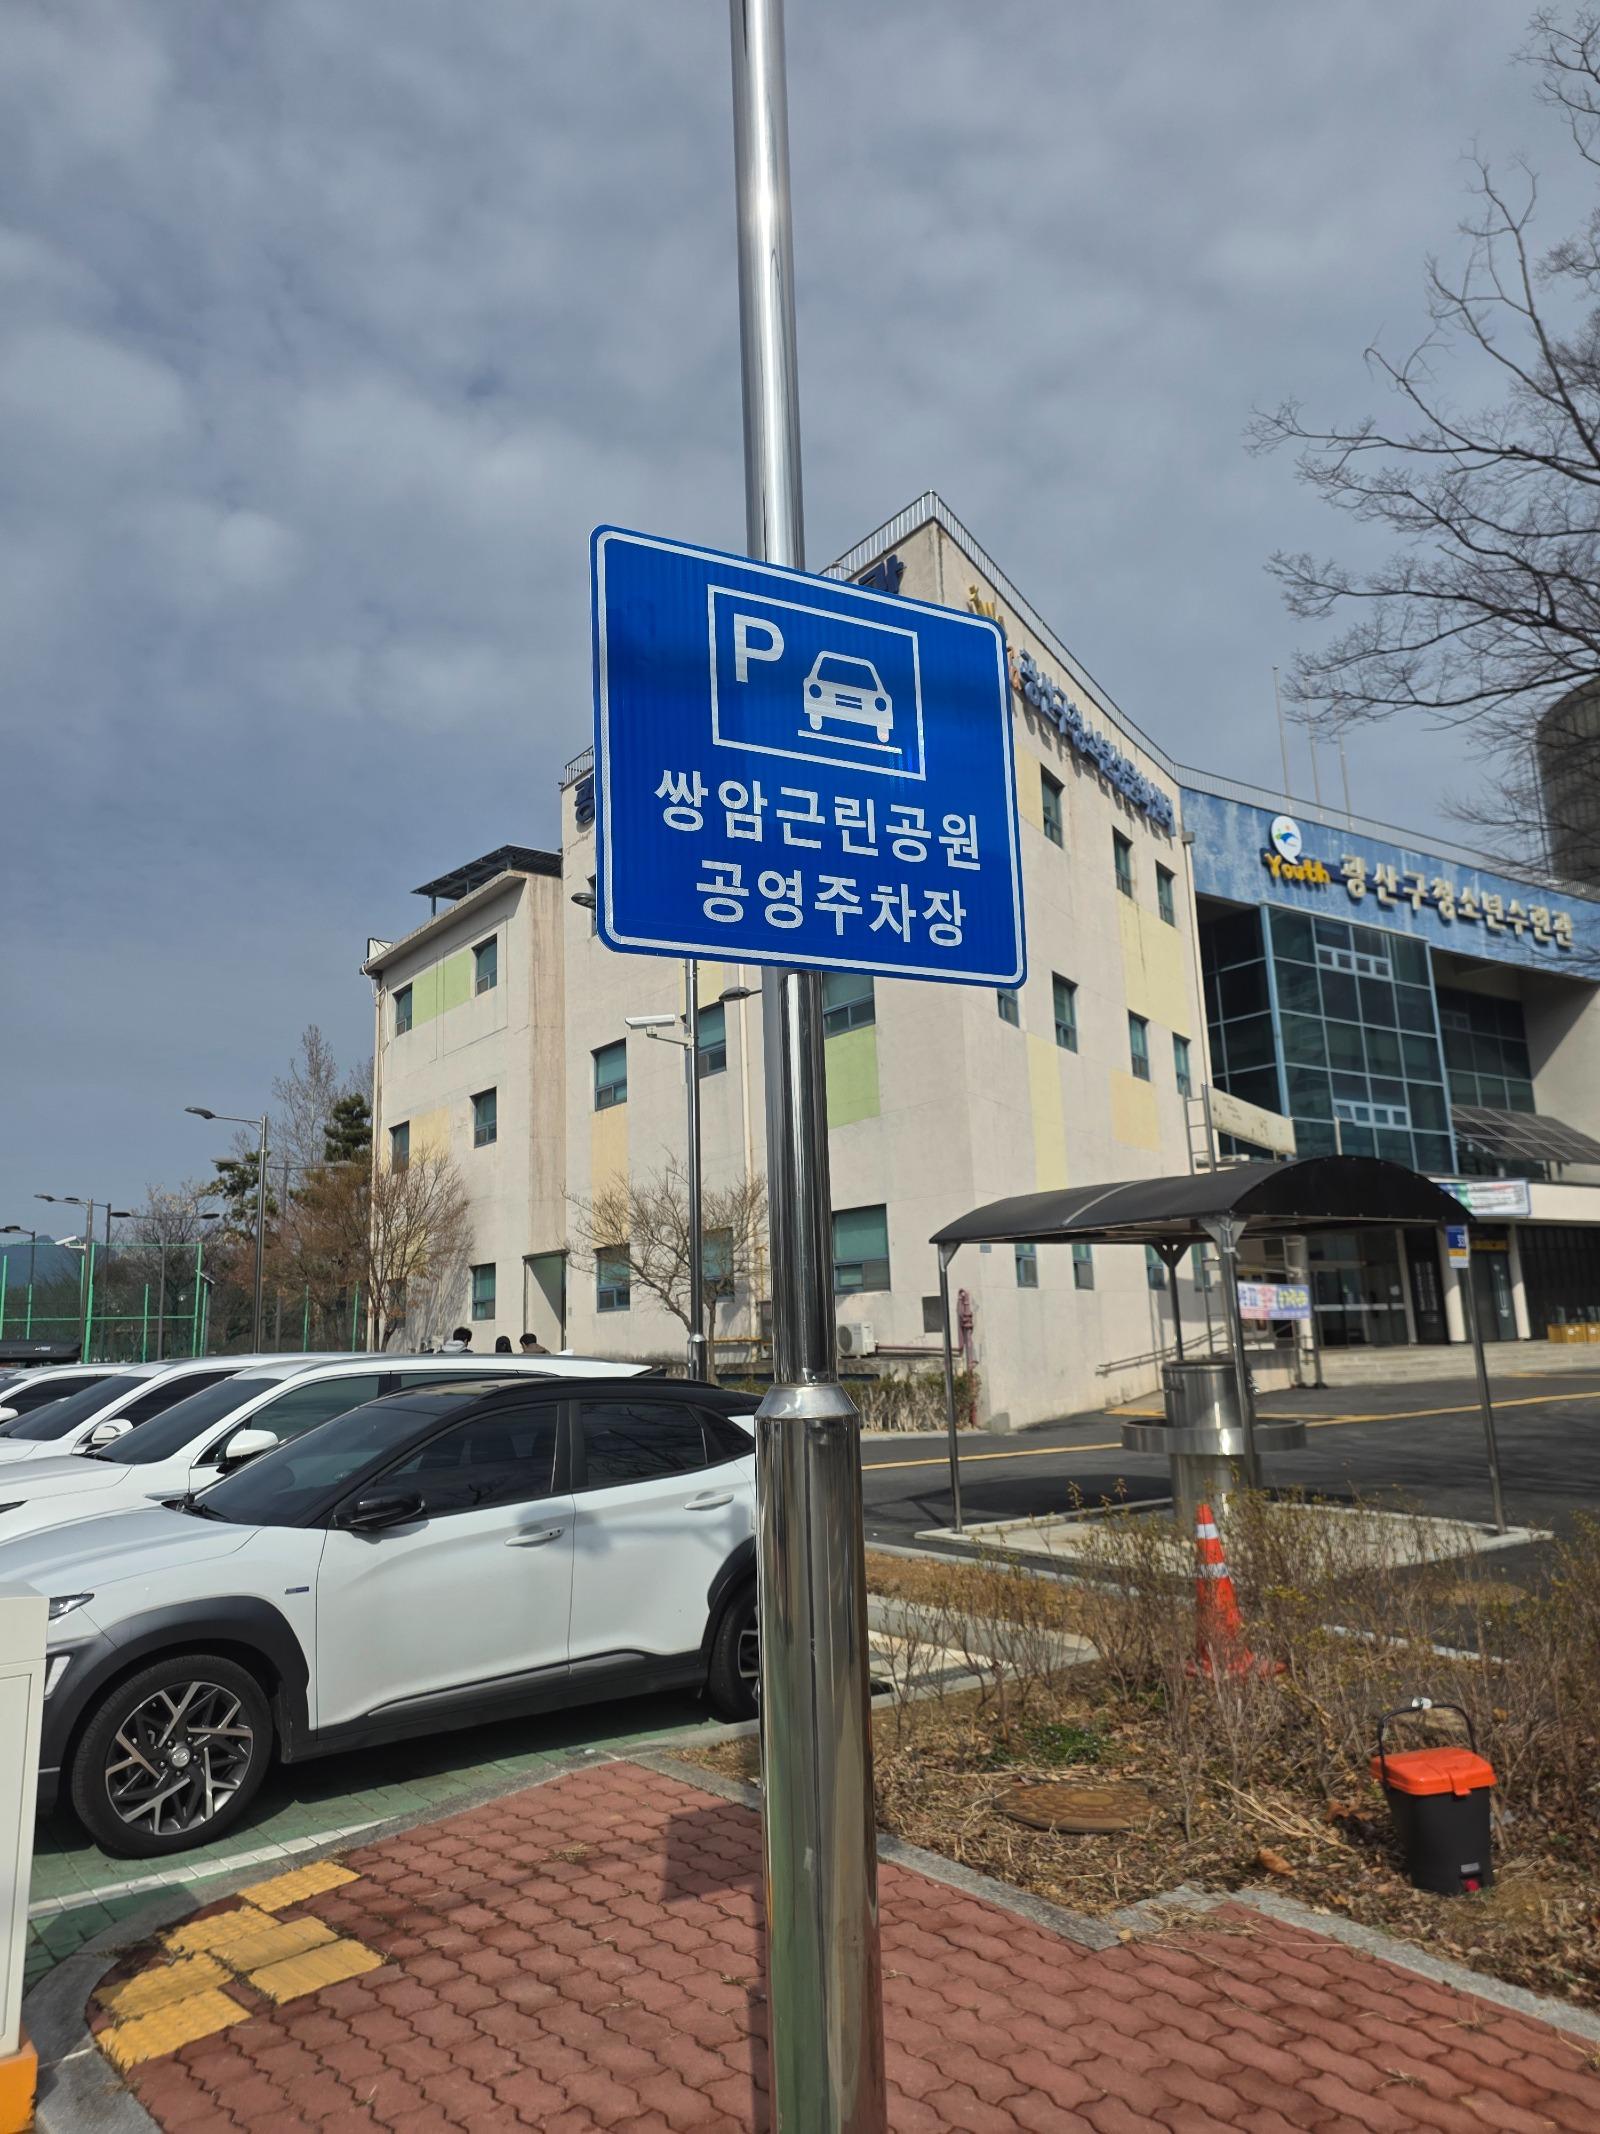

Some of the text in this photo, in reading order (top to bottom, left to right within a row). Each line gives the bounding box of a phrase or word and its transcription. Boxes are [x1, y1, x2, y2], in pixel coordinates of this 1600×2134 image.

[733, 613, 784, 683] P
[655, 769, 981, 871] 쌍암근린공원
[696, 859, 967, 946] 공영주차장
[1263, 853, 1331, 885] Youth
